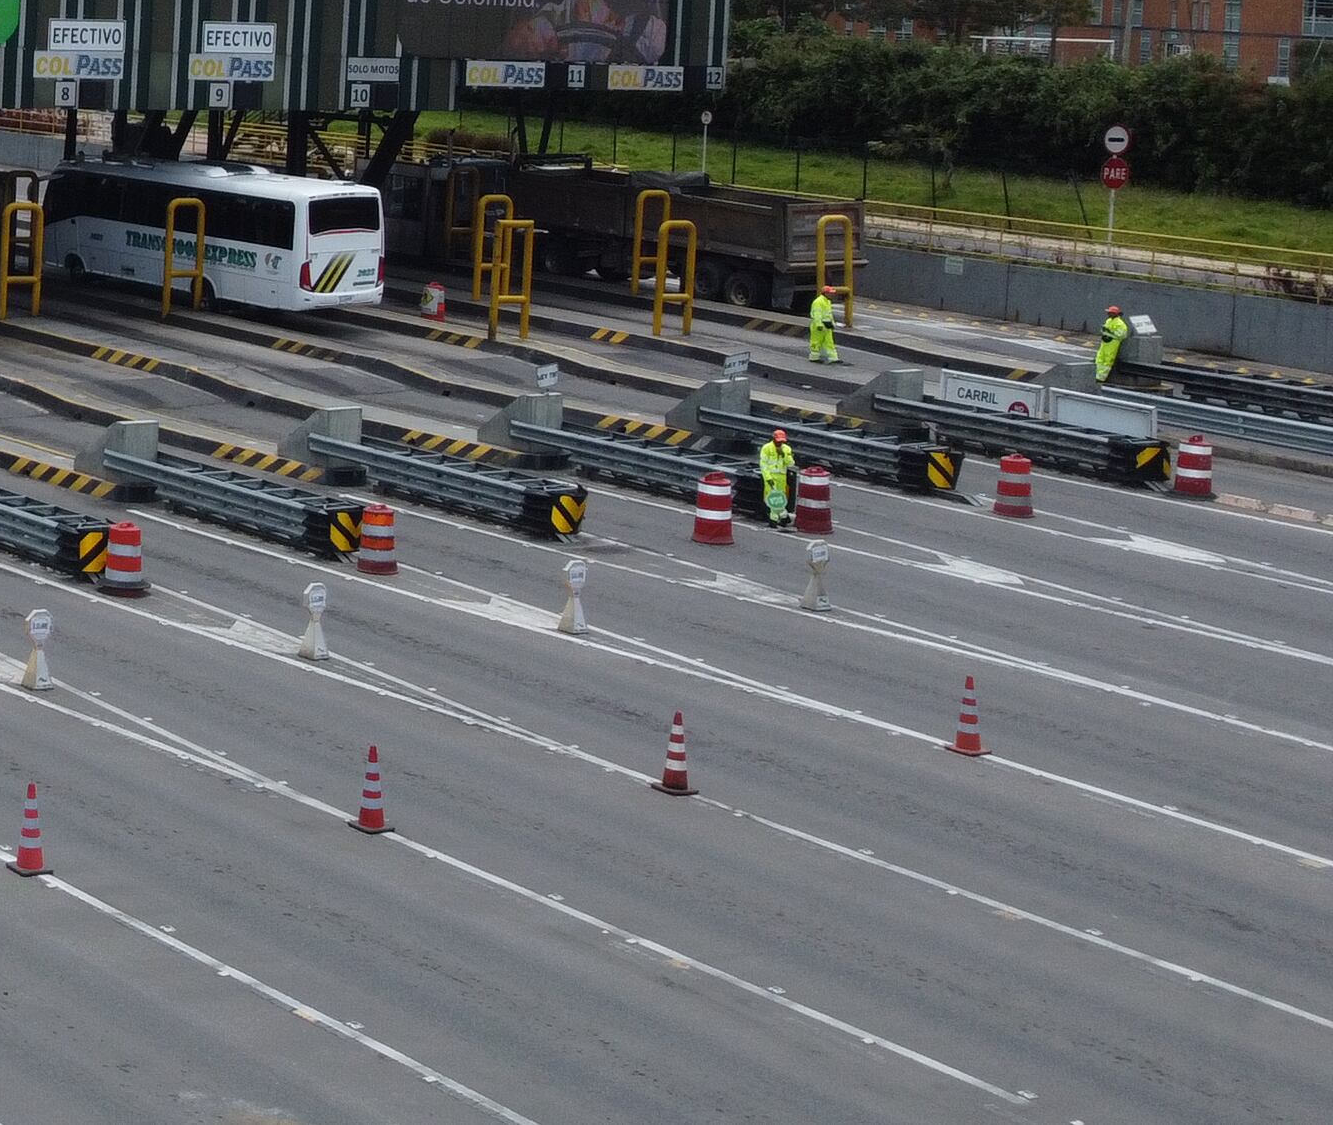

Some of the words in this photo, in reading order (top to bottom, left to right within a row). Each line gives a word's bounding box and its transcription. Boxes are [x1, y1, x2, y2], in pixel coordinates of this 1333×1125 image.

[53, 28, 122, 45] EFECTIVO
[206, 30, 272, 47] EFECTIVO
[348, 64, 370, 74] SOLO
[371, 65, 399, 74] MOTOS
[569, 69, 583, 82] 11
[708, 71, 721, 85] 12
[61, 87, 70, 101] 8
[215, 89, 224, 102] 9
[353, 89, 368, 102] 10
[1103, 167, 1127, 180] PARE
[957, 387, 999, 405] CARRIL
